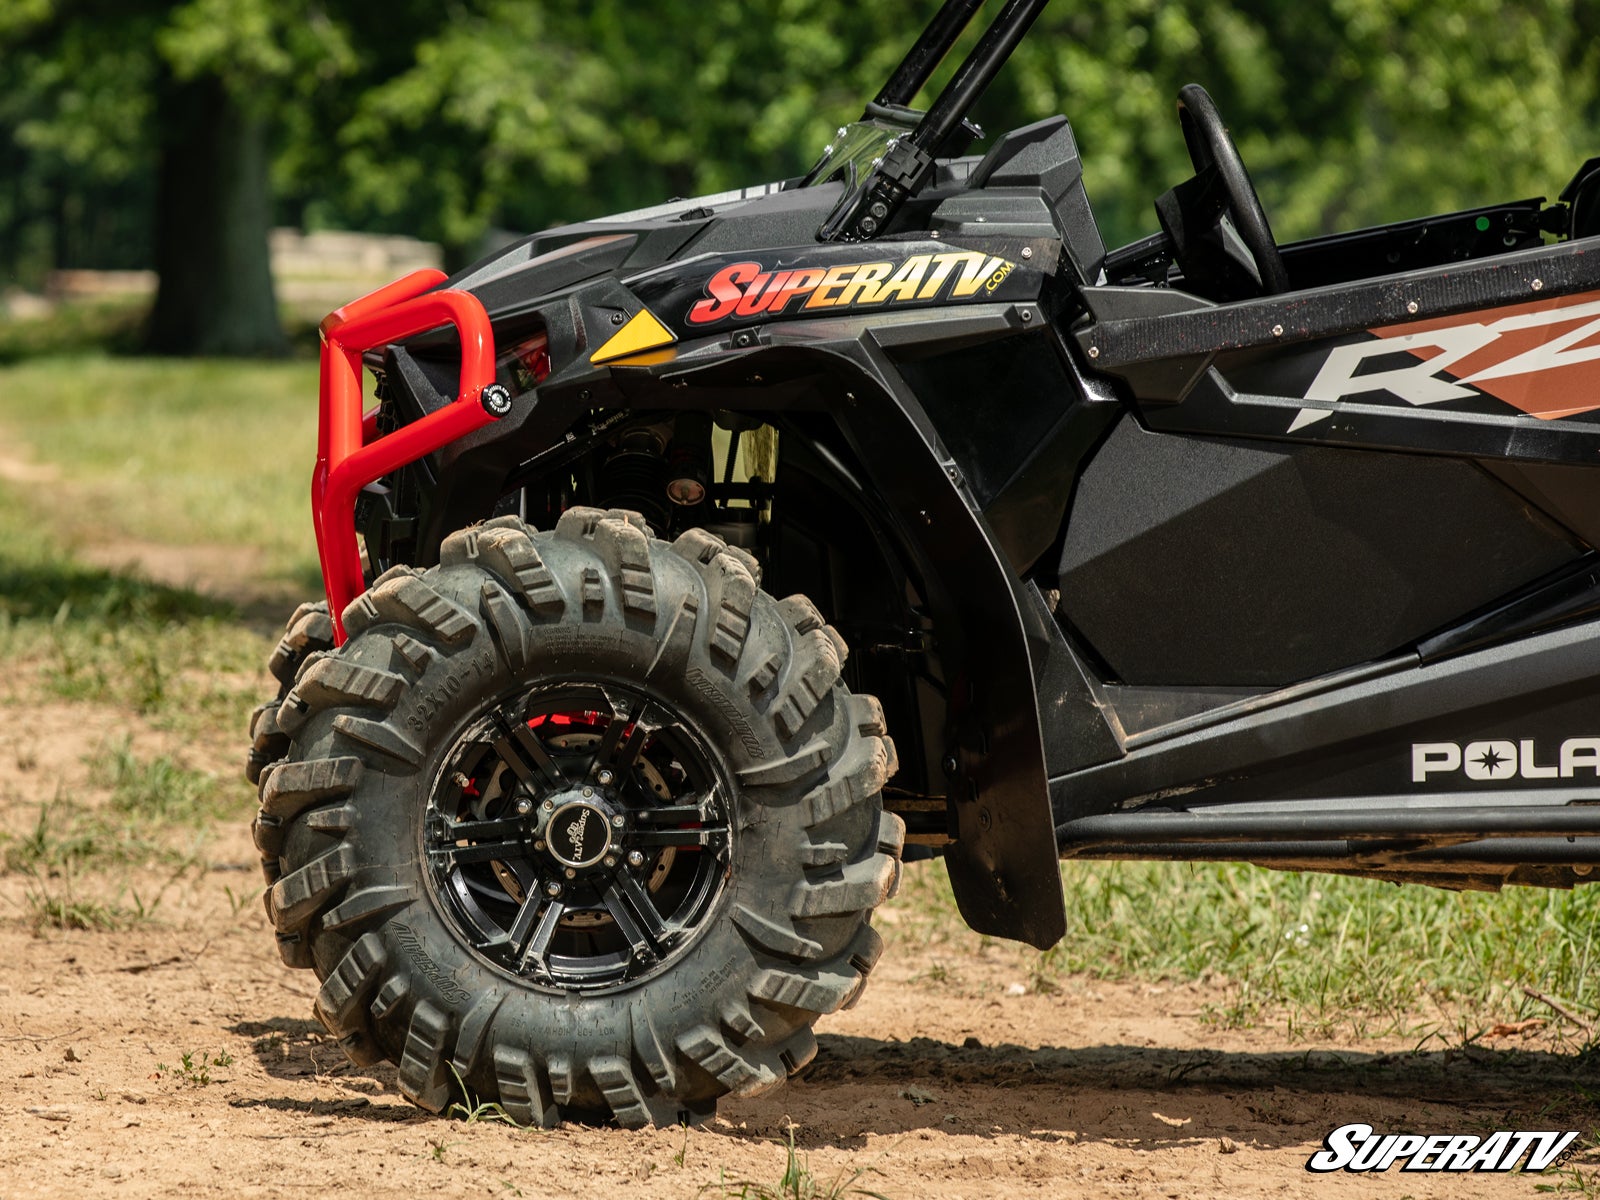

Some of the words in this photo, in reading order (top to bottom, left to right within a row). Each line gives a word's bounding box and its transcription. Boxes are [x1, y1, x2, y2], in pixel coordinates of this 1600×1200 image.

[689, 252, 1005, 323] SUPERATV
[509, 1016, 526, 1031] USE
[577, 1027, 593, 1037] FOR
[598, 1026, 616, 1037] NOT
